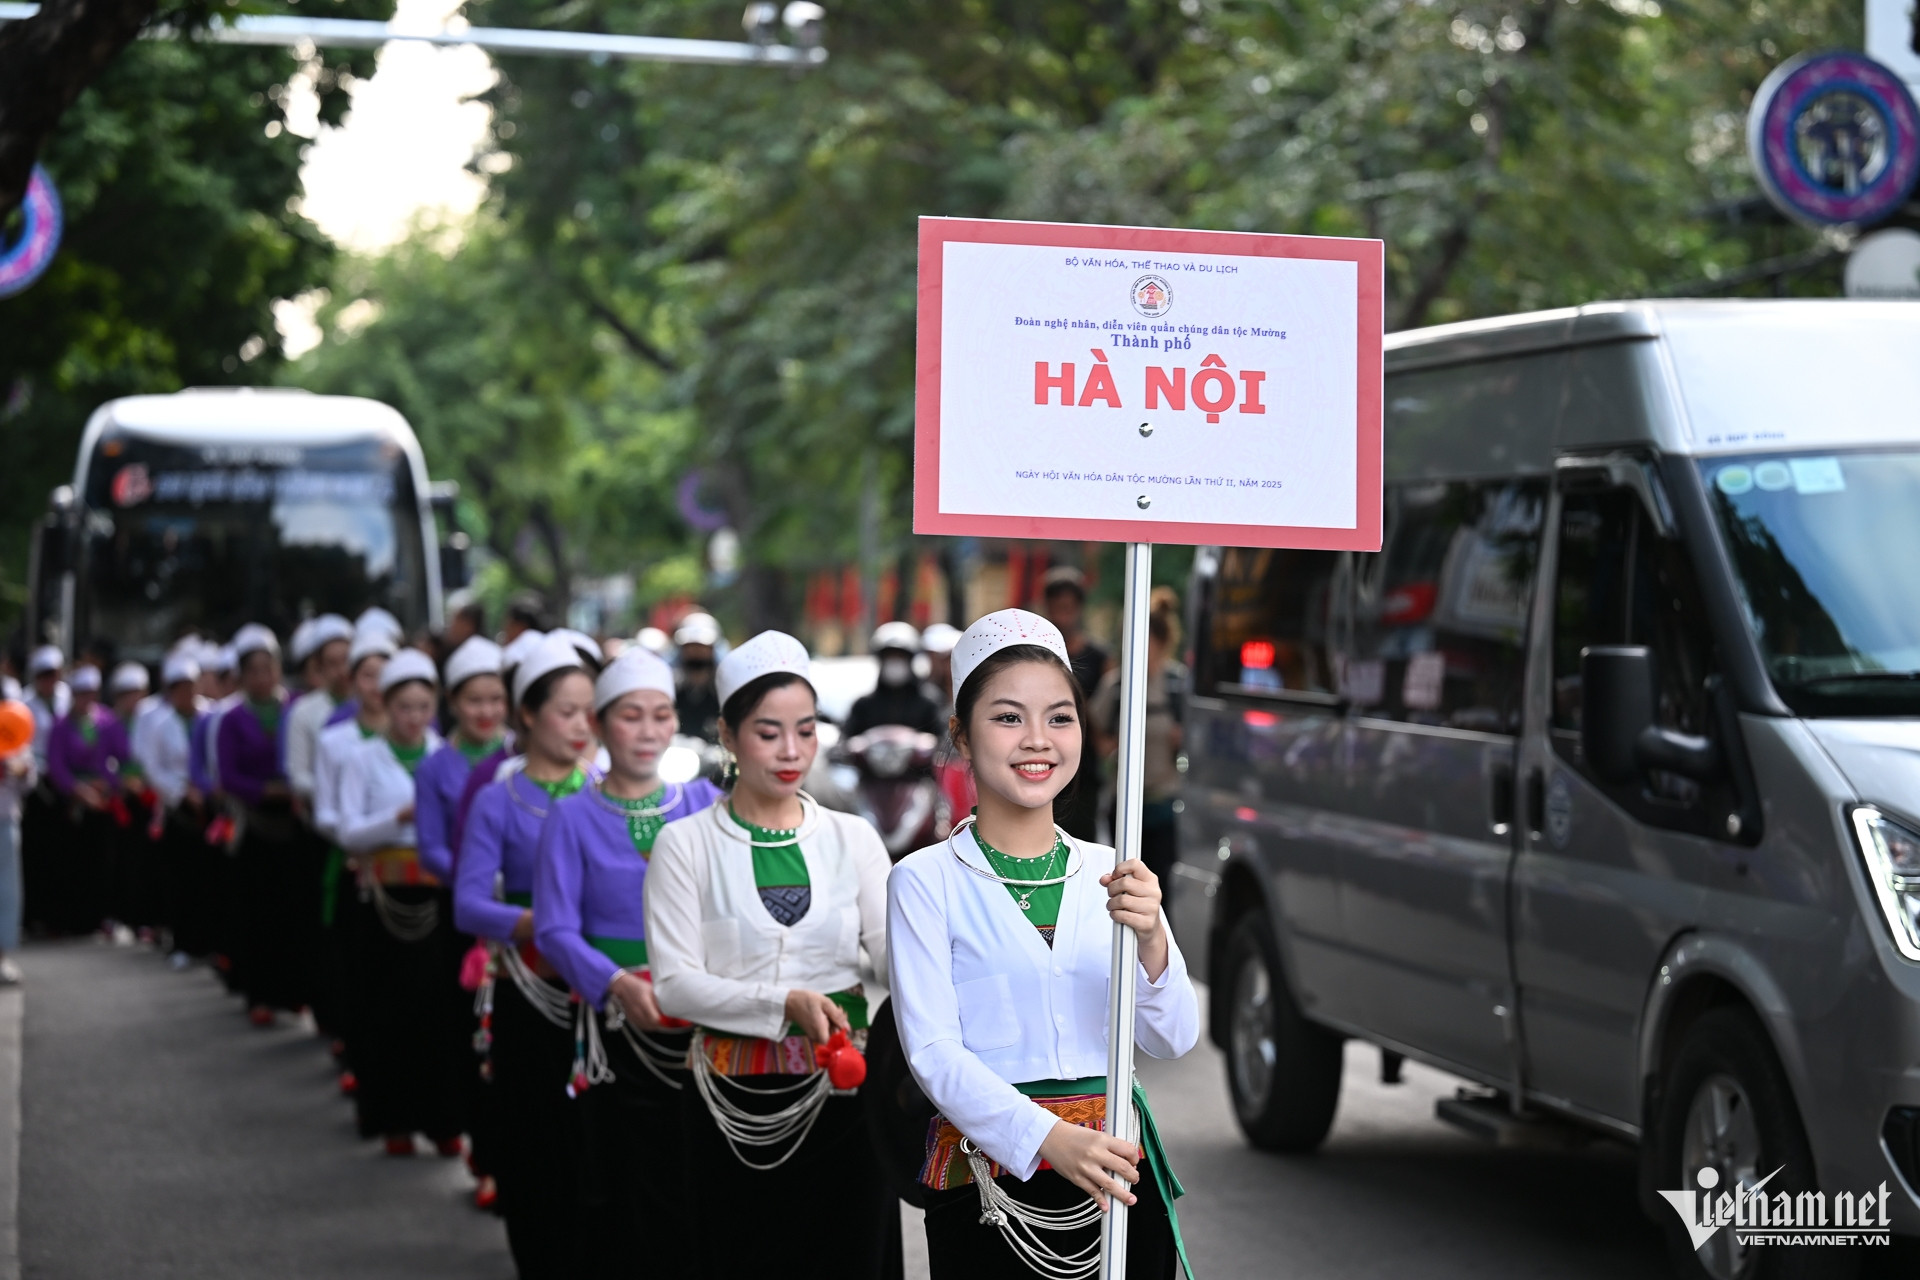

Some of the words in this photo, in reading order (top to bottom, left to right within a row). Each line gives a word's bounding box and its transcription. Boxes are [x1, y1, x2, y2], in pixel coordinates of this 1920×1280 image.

[1065, 256, 1079, 267] BỘ
[1082, 257, 1102, 267] VĂN
[1104, 258, 1128, 270] HÓA,
[1153, 262, 1180, 271] THAO
[1183, 261, 1196, 272] VÀ
[1199, 264, 1213, 273] DU
[1216, 265, 1238, 275] LỊCH
[1014, 317, 1041, 327] Đoàn
[1044, 318, 1068, 330] nghệ
[1071, 319, 1100, 331] nhân,
[1102, 319, 1123, 330] diễn
[1127, 320, 1147, 331] viên
[1150, 320, 1175, 334] quần
[1178, 324, 1209, 336] chúng
[1211, 325, 1230, 335] dân
[1233, 326, 1248, 338] tộc
[1250, 327, 1287, 340] Mường
[1110, 333, 1159, 349] Thành
[1164, 333, 1192, 352] phố
[1034, 348, 1122, 408] HÀ
[1145, 353, 1266, 424] NỘI
[1015, 469, 1040, 479] NGÀY
[1042, 470, 1059, 481] HỘI
[1062, 470, 1080, 480] VĂN
[1083, 472, 1103, 481] HÓA
[1105, 472, 1124, 482] DÂN
[1126, 473, 1145, 484] TỘC
[1148, 474, 1182, 485] MƯỜNG
[1184, 475, 1202, 485] LẦN
[1204, 476, 1223, 486] THỨ
[1226, 478, 1236, 488] II,
[1239, 477, 1258, 487] NĂM
[1261, 480, 1282, 489] 2025
